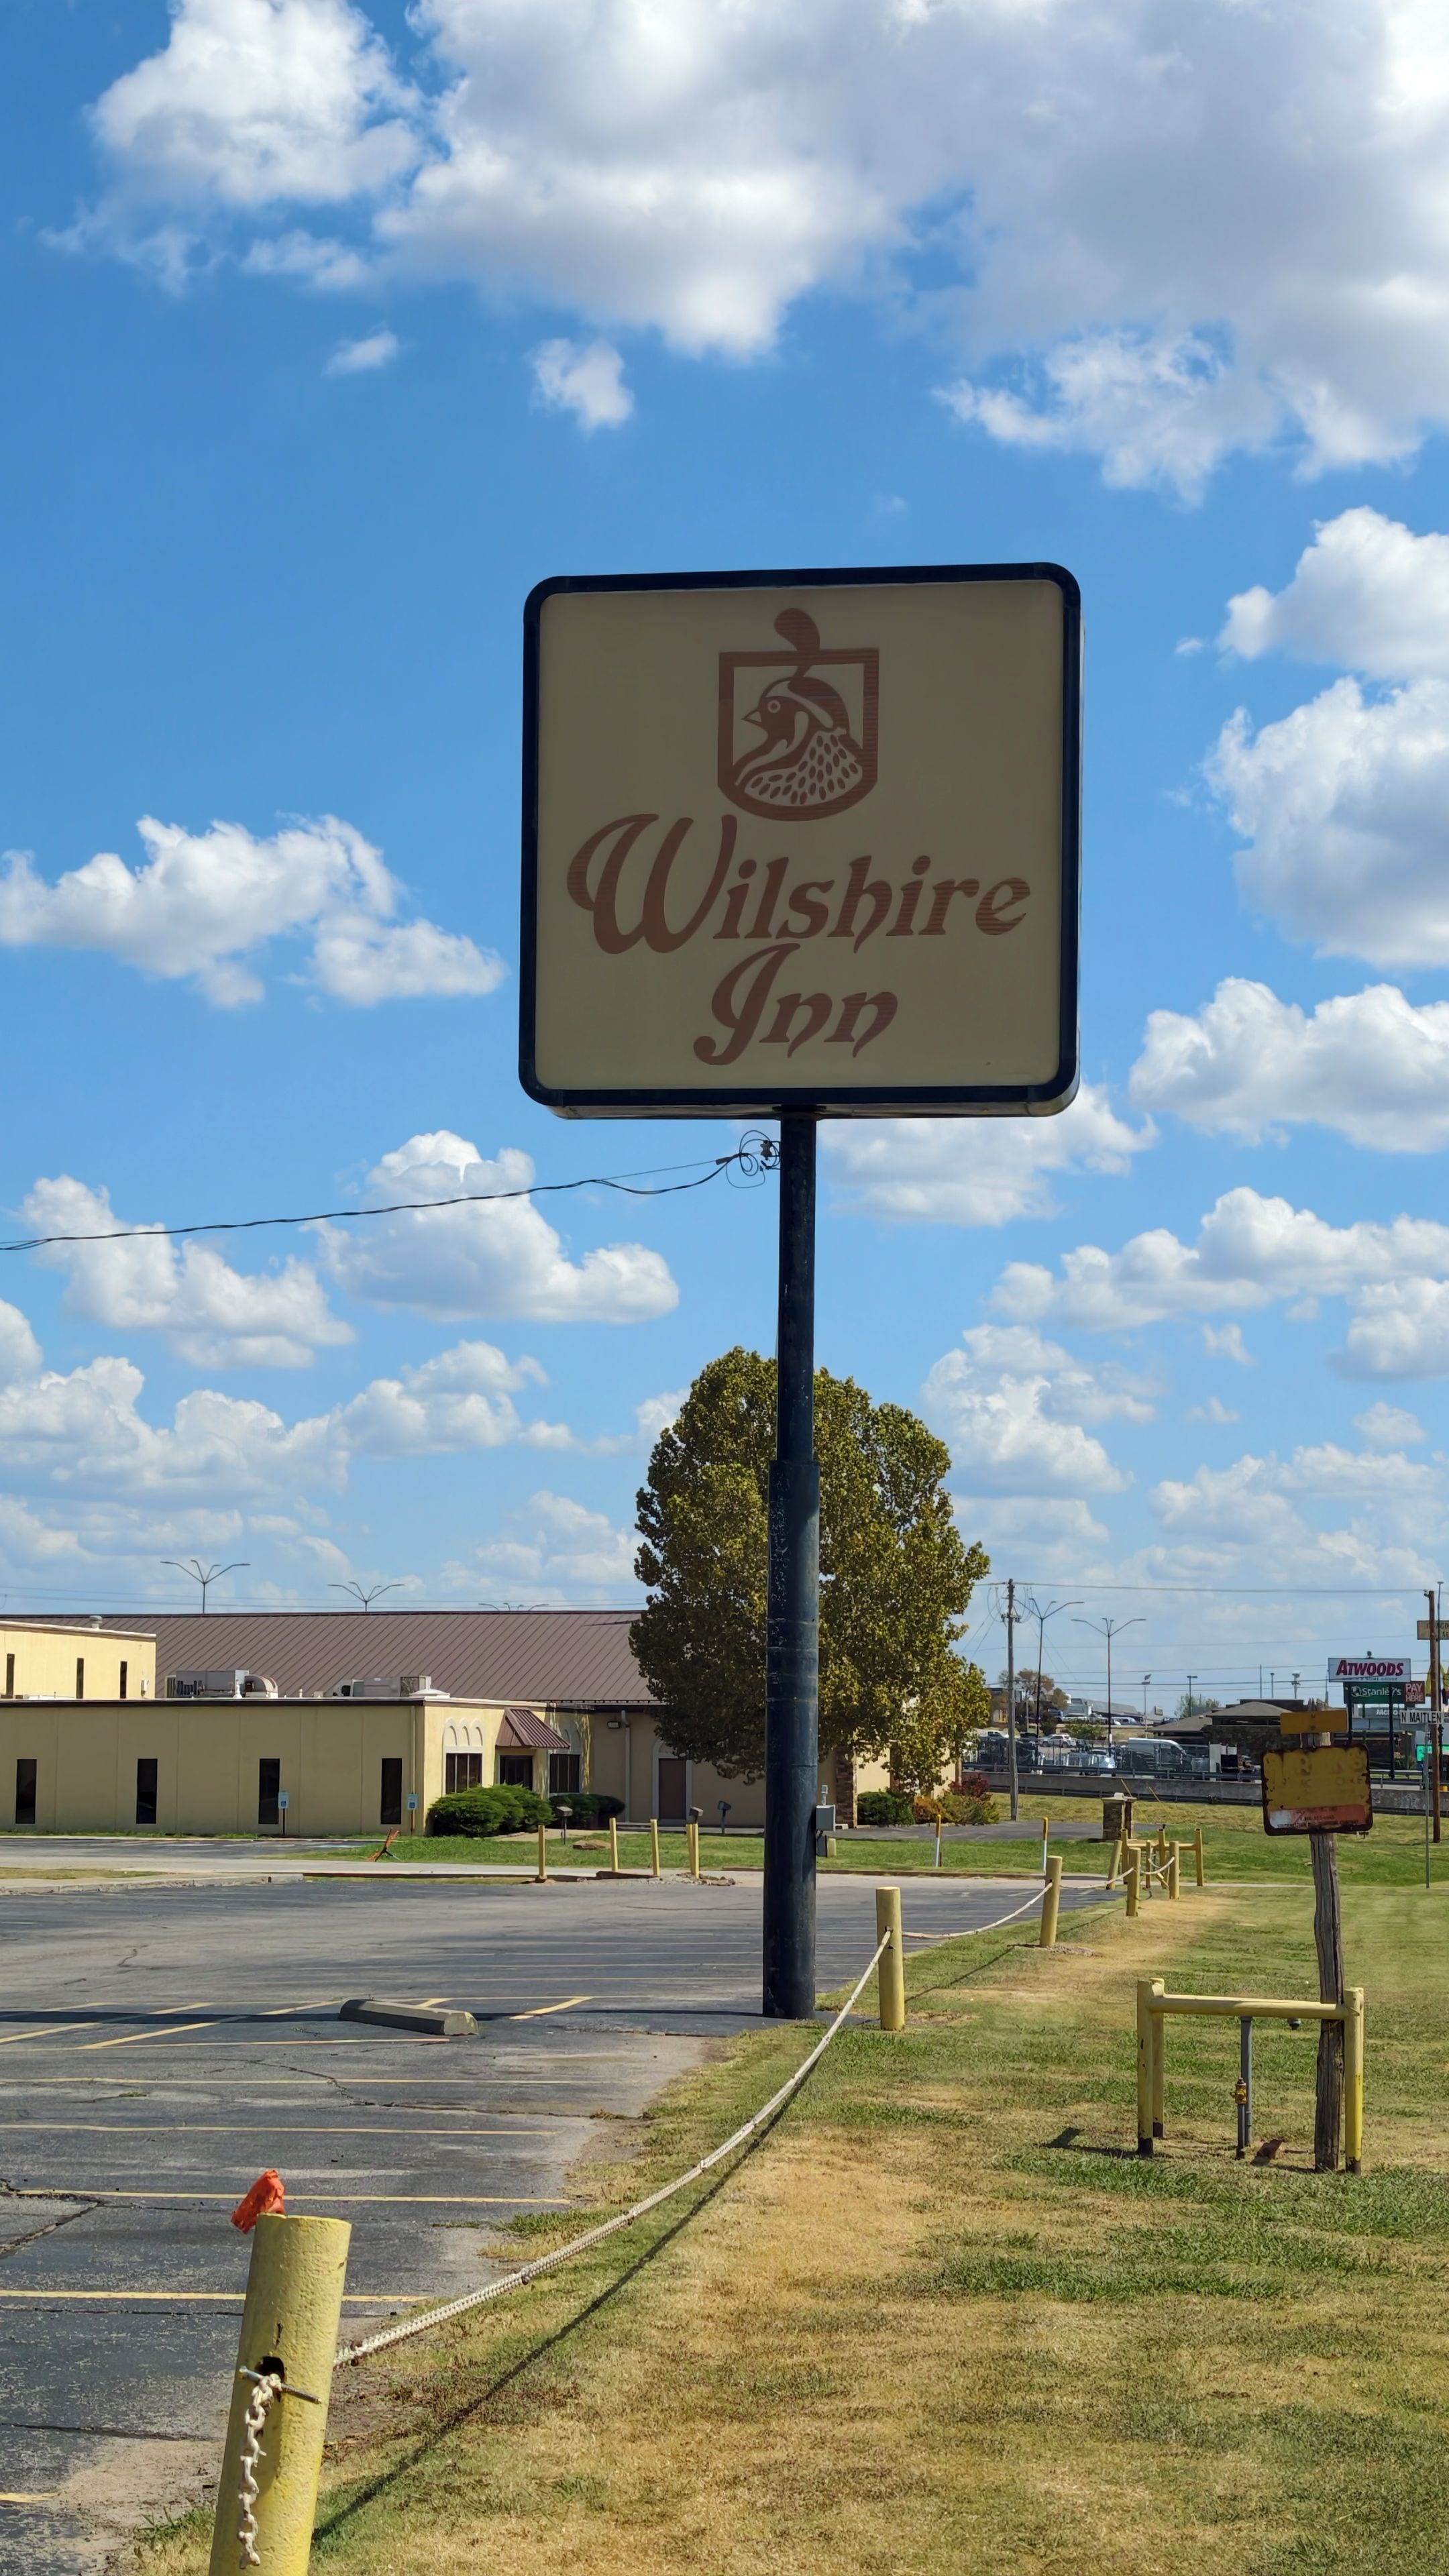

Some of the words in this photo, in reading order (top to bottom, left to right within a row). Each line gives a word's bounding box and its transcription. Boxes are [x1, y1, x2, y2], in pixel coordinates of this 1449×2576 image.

[566, 813, 1031, 955] Wilshire
[693, 943, 899, 1065] Inn
[1336, 1660, 1403, 1676] ATWOODS
[1405, 1683, 1423, 1693] PAY
[1401, 1711, 1407, 1723] N
[1409, 1711, 1442, 1723] MAITLEN
